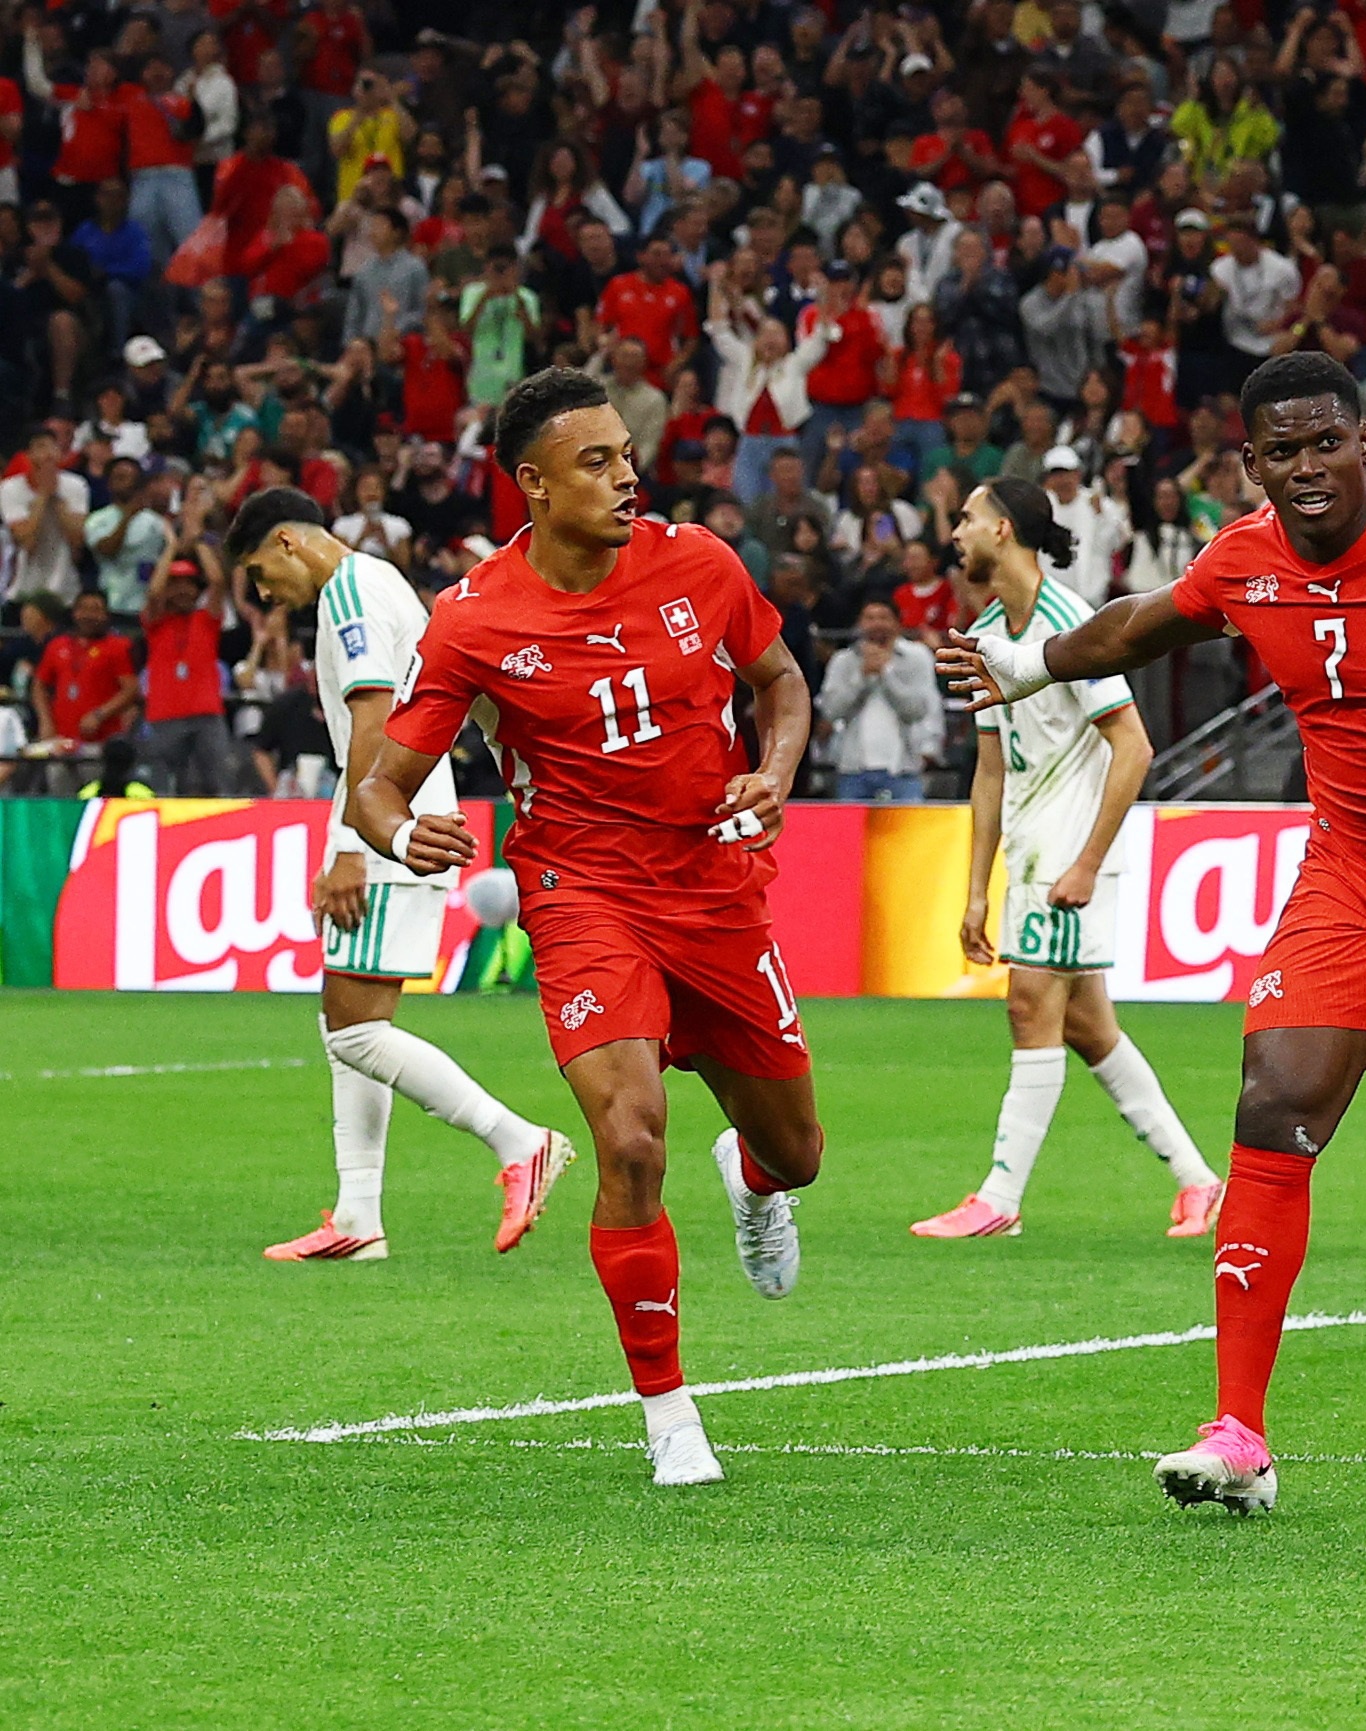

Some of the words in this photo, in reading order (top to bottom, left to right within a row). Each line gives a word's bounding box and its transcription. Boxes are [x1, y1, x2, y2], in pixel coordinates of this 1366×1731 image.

[1313, 617, 1348, 699] 7
[588, 666, 662, 754] 11
[1010, 730, 1027, 773] 6
[114, 810, 324, 992] Lay
[1020, 911, 1046, 955] 6
